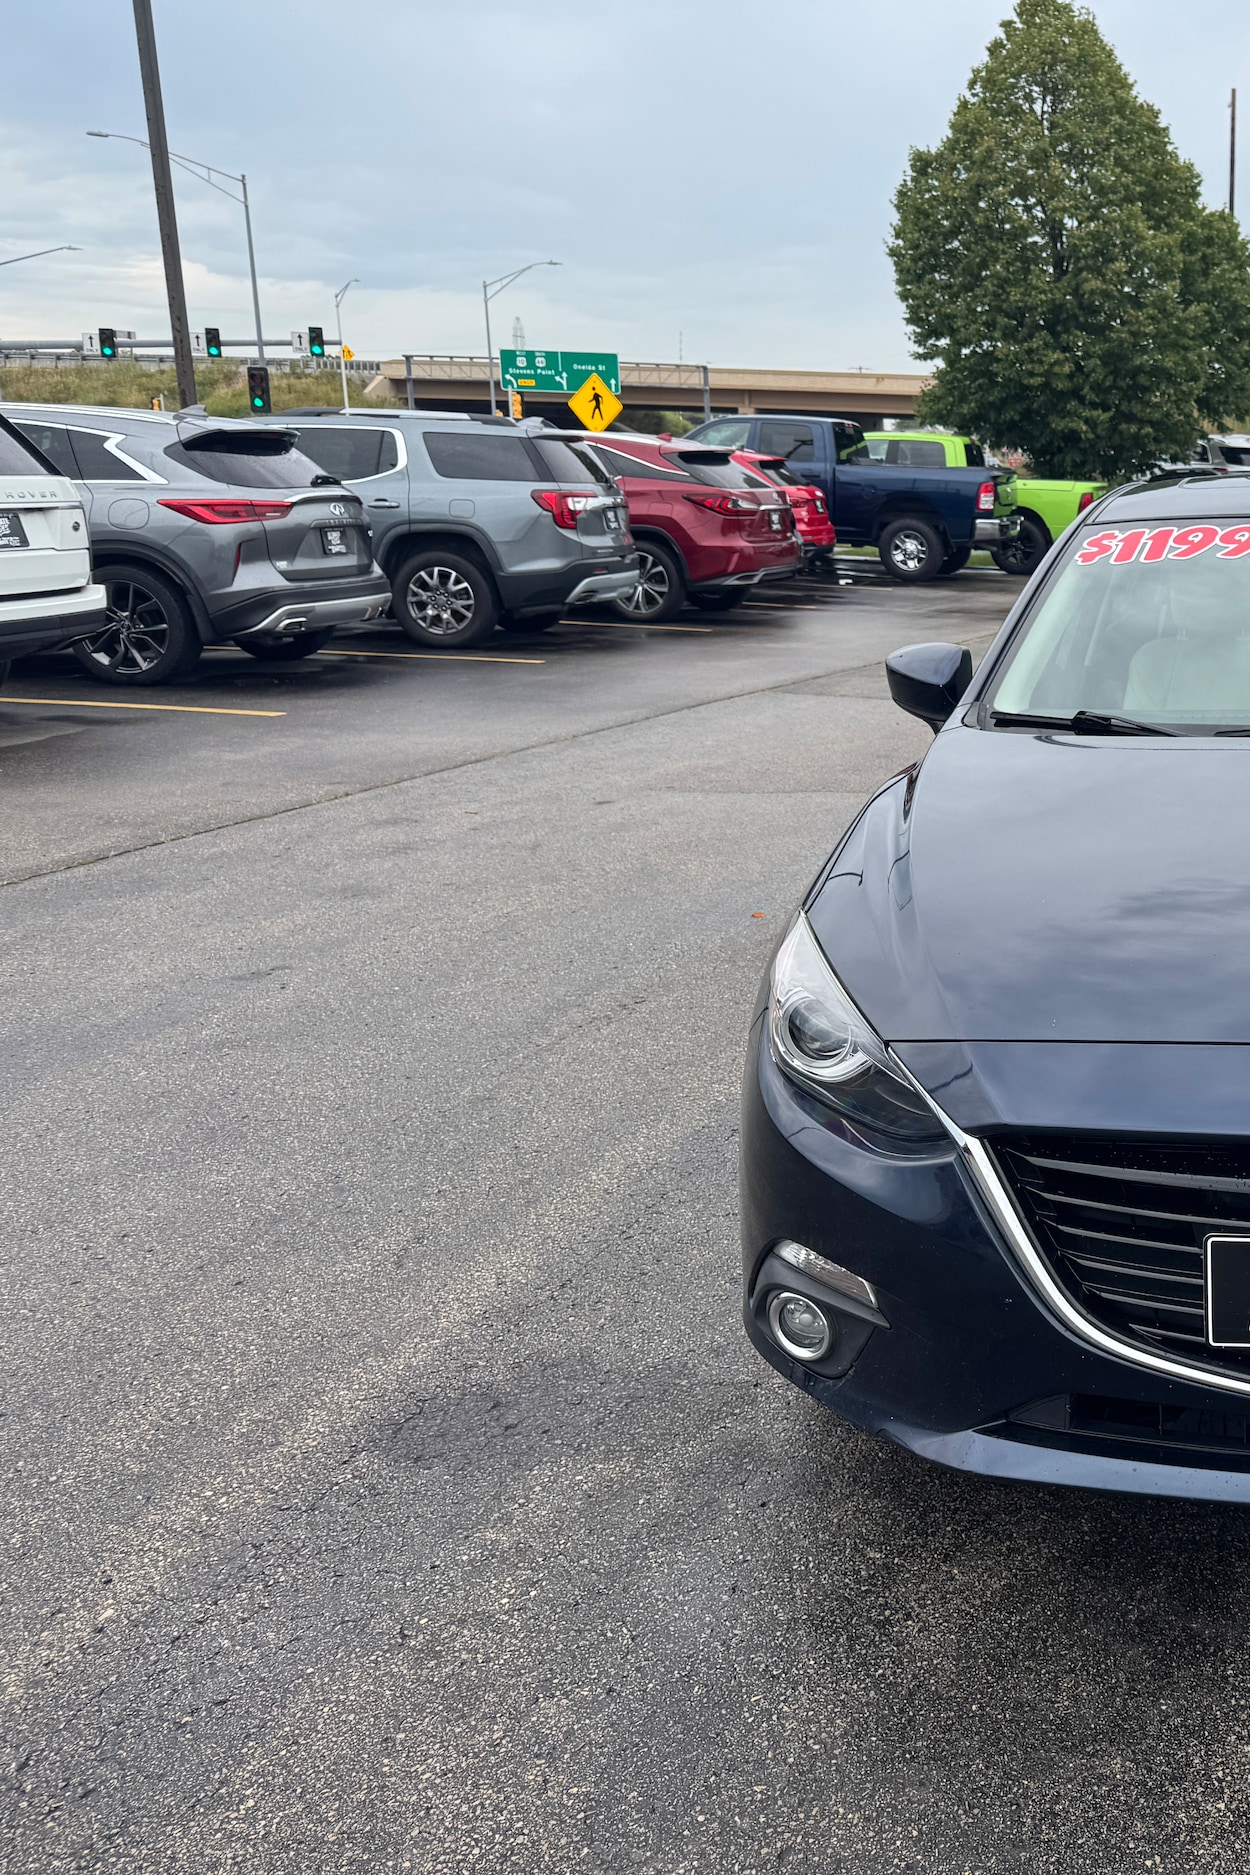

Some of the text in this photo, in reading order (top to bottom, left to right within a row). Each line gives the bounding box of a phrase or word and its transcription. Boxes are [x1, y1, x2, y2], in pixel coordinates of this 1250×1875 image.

[508, 367, 535, 375] Stevens
[573, 363, 596, 371] Oneida
[5, 490, 58, 499] ROVER
